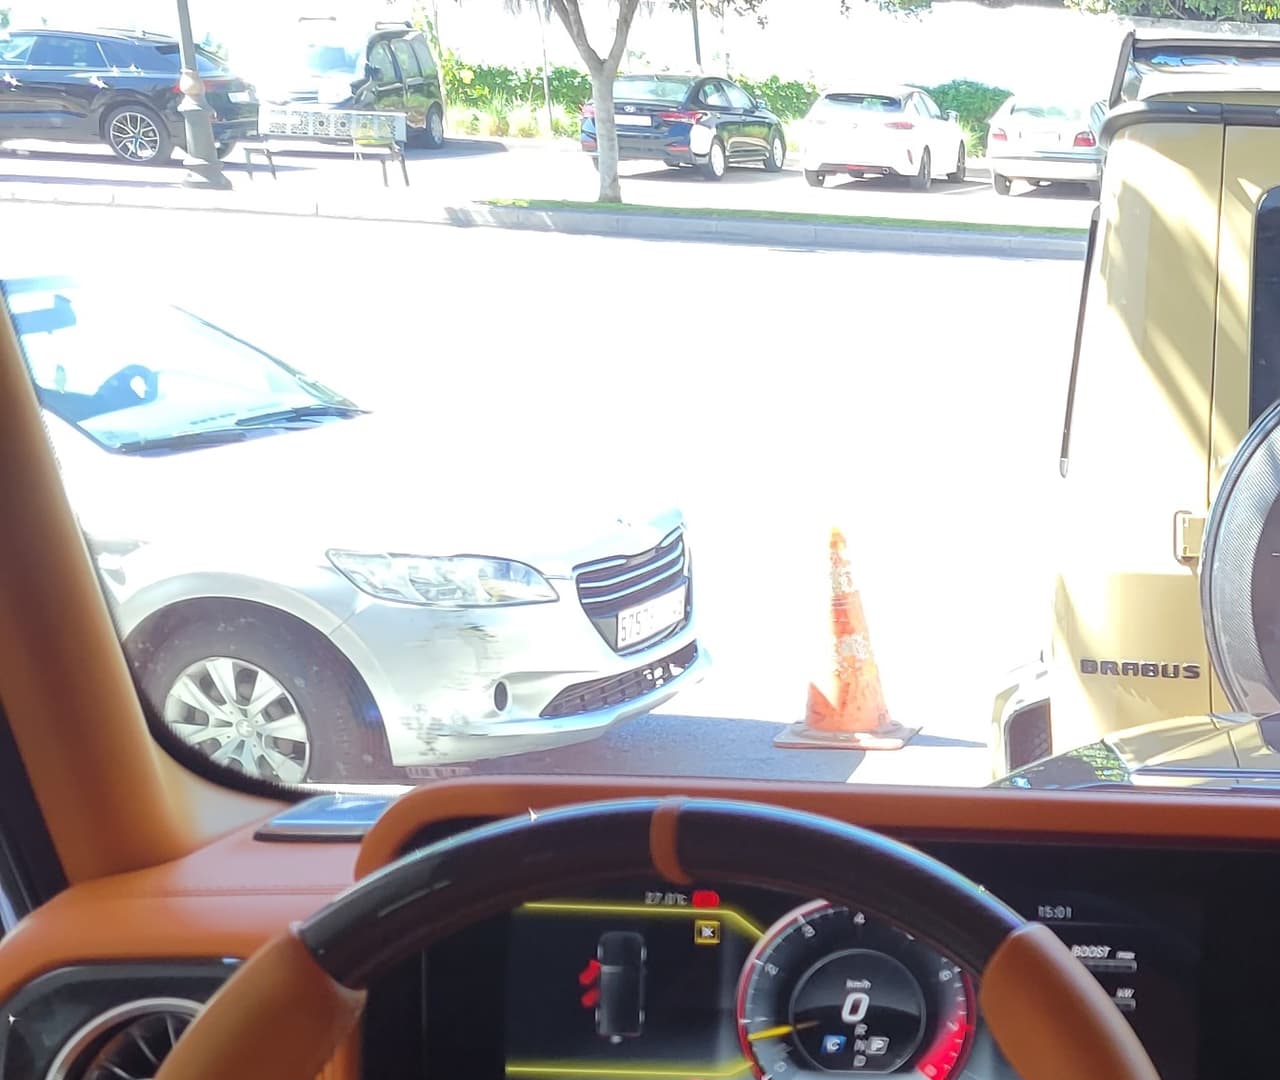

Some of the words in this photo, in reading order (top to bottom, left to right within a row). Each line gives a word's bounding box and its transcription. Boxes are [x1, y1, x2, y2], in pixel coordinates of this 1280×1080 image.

[1080, 659, 1201, 679] BRABUS
[1038, 905, 1072, 919] 15:01
[1071, 944, 1112, 958] BOOST
[841, 991, 870, 1024] 0
